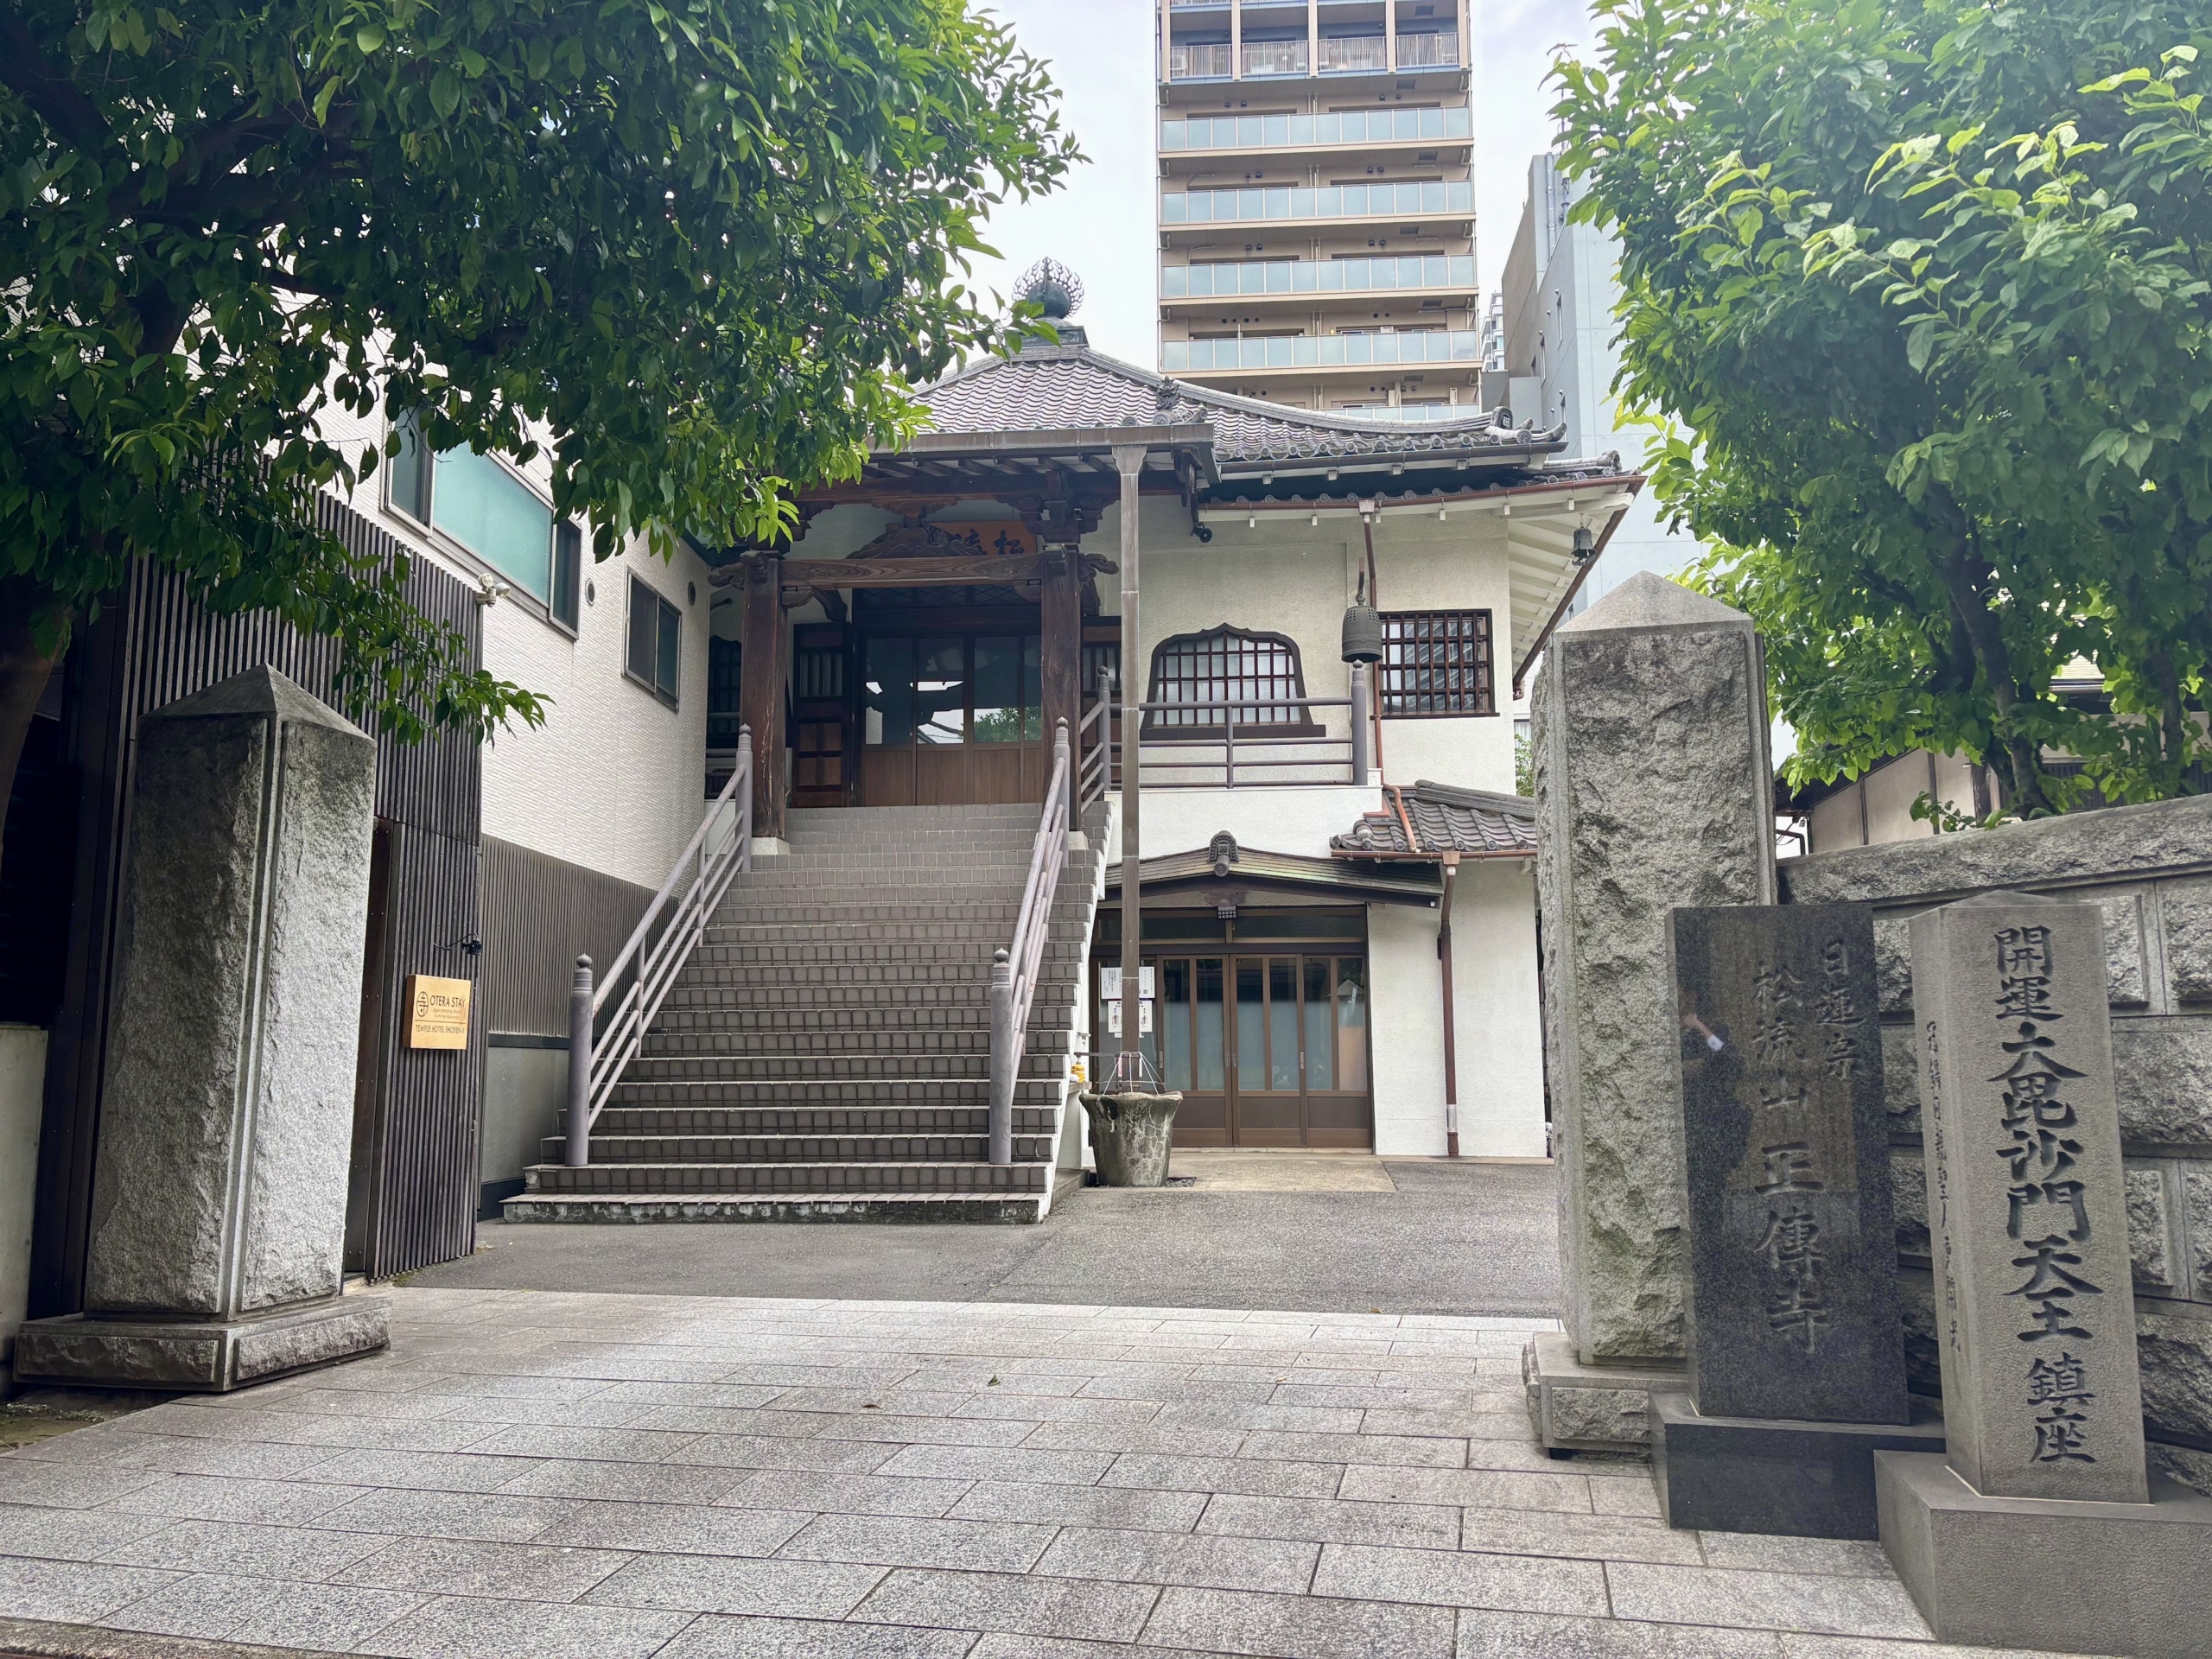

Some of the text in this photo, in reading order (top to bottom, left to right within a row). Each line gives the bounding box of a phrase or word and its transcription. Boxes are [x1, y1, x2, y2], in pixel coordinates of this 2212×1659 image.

[430, 995, 466, 1008] OTERA STAY
[1815, 938, 1866, 1082] 日蓮宗
[416, 1024, 431, 1033] TEMPLE
[432, 1025, 444, 1033] HOTEL
